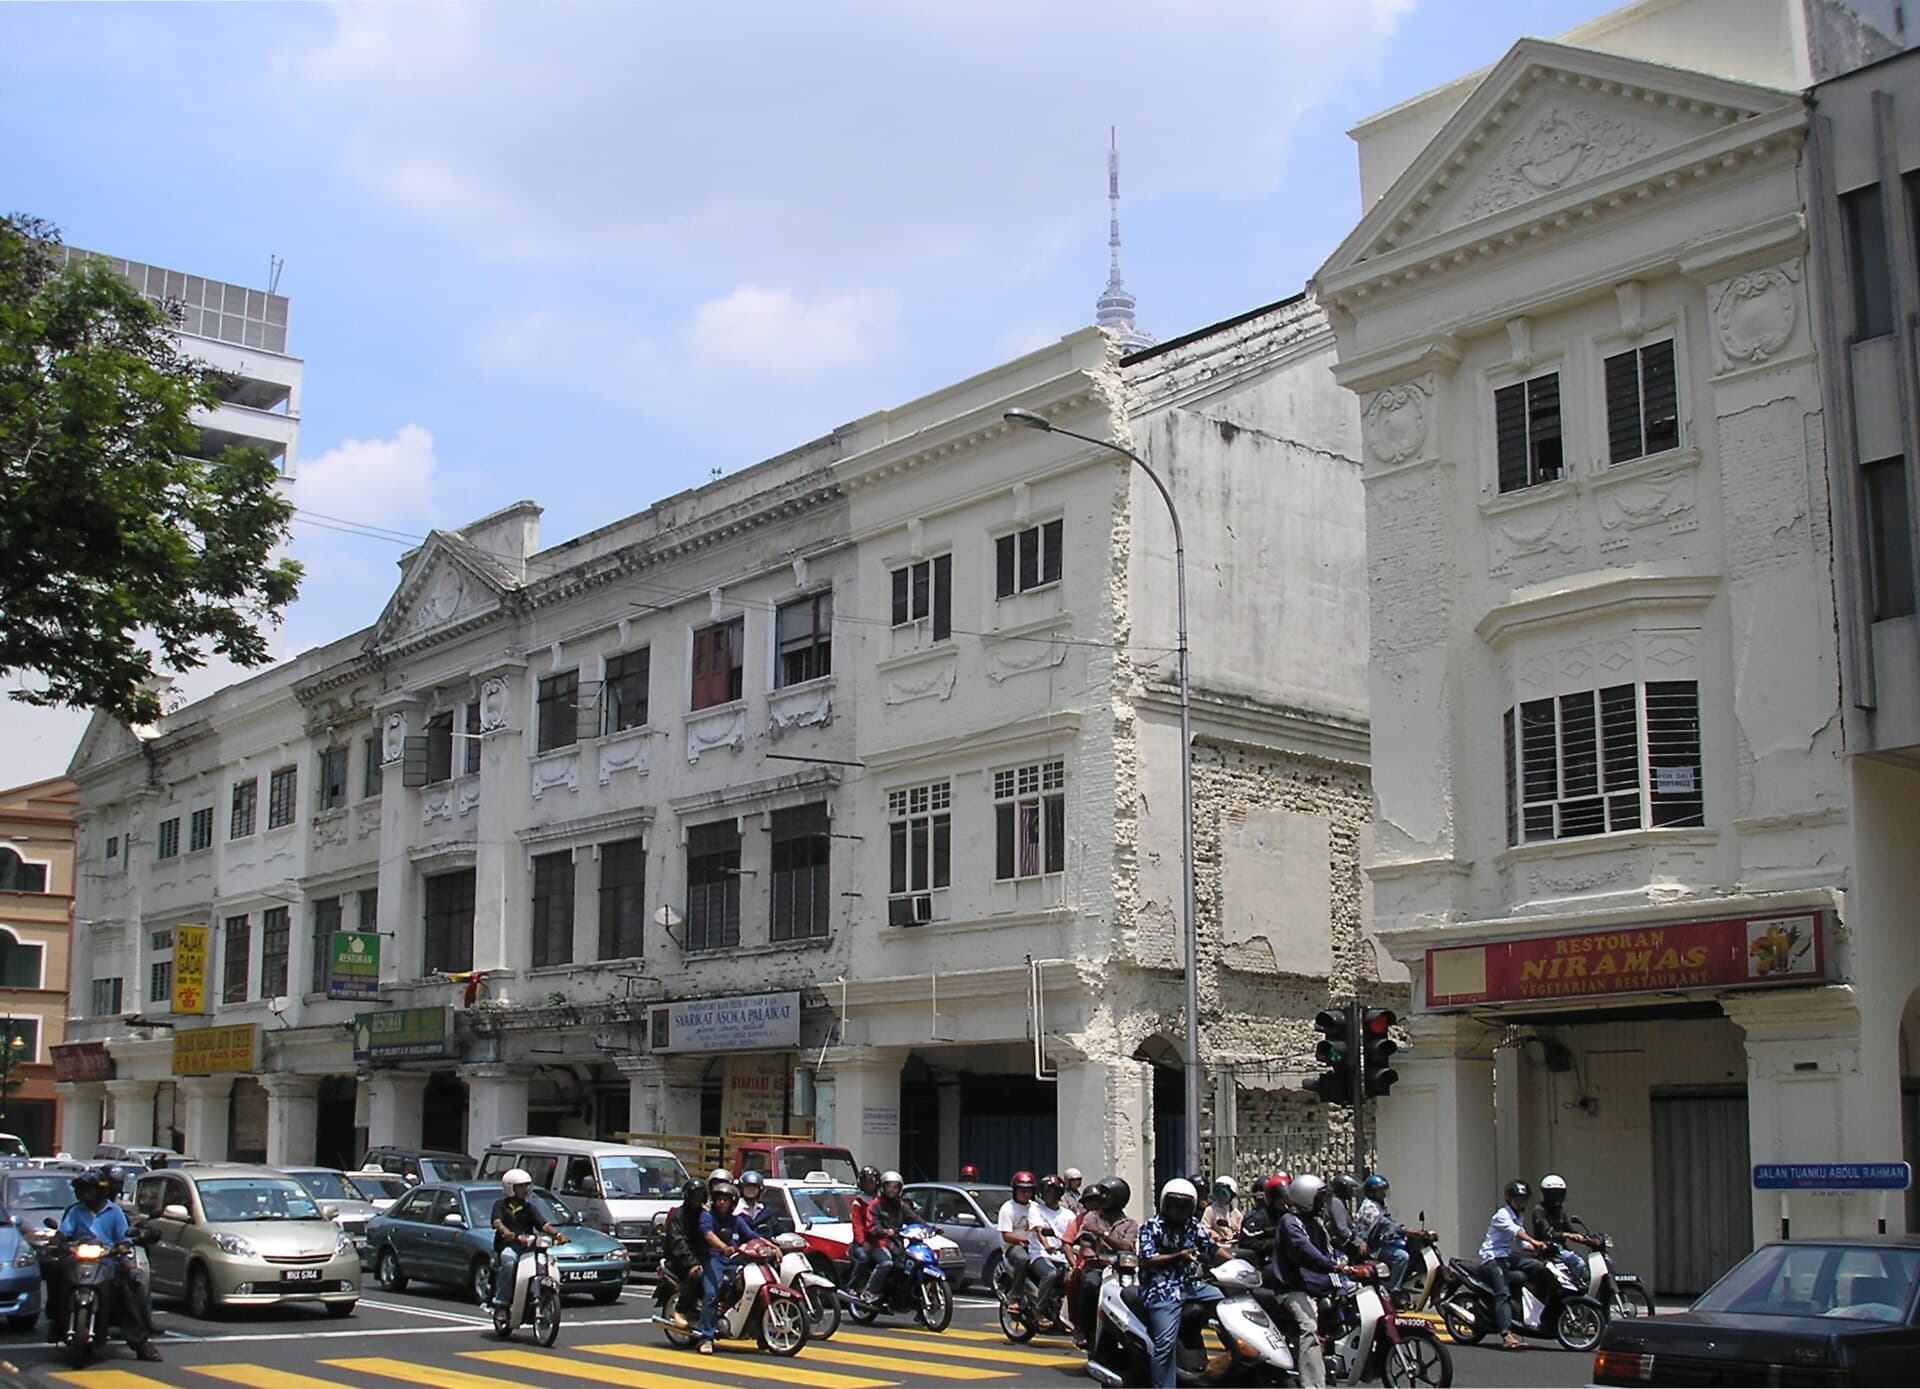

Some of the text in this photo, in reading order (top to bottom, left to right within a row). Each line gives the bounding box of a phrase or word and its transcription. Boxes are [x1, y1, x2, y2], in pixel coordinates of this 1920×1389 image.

[178, 930, 204, 953] PAJAK
[1556, 930, 1665, 954] RESTORAN
[177, 954, 203, 976] GADAI
[1519, 946, 1709, 982] NIRAMAS
[1520, 970, 1708, 997] VEGETARIAN RESTAURANT
[674, 1005, 791, 1028] SYARIKAT ASOKA PALAIKAT
[1757, 1166, 1905, 1179] JALAN TUANKU ABDUL RAHMAN
